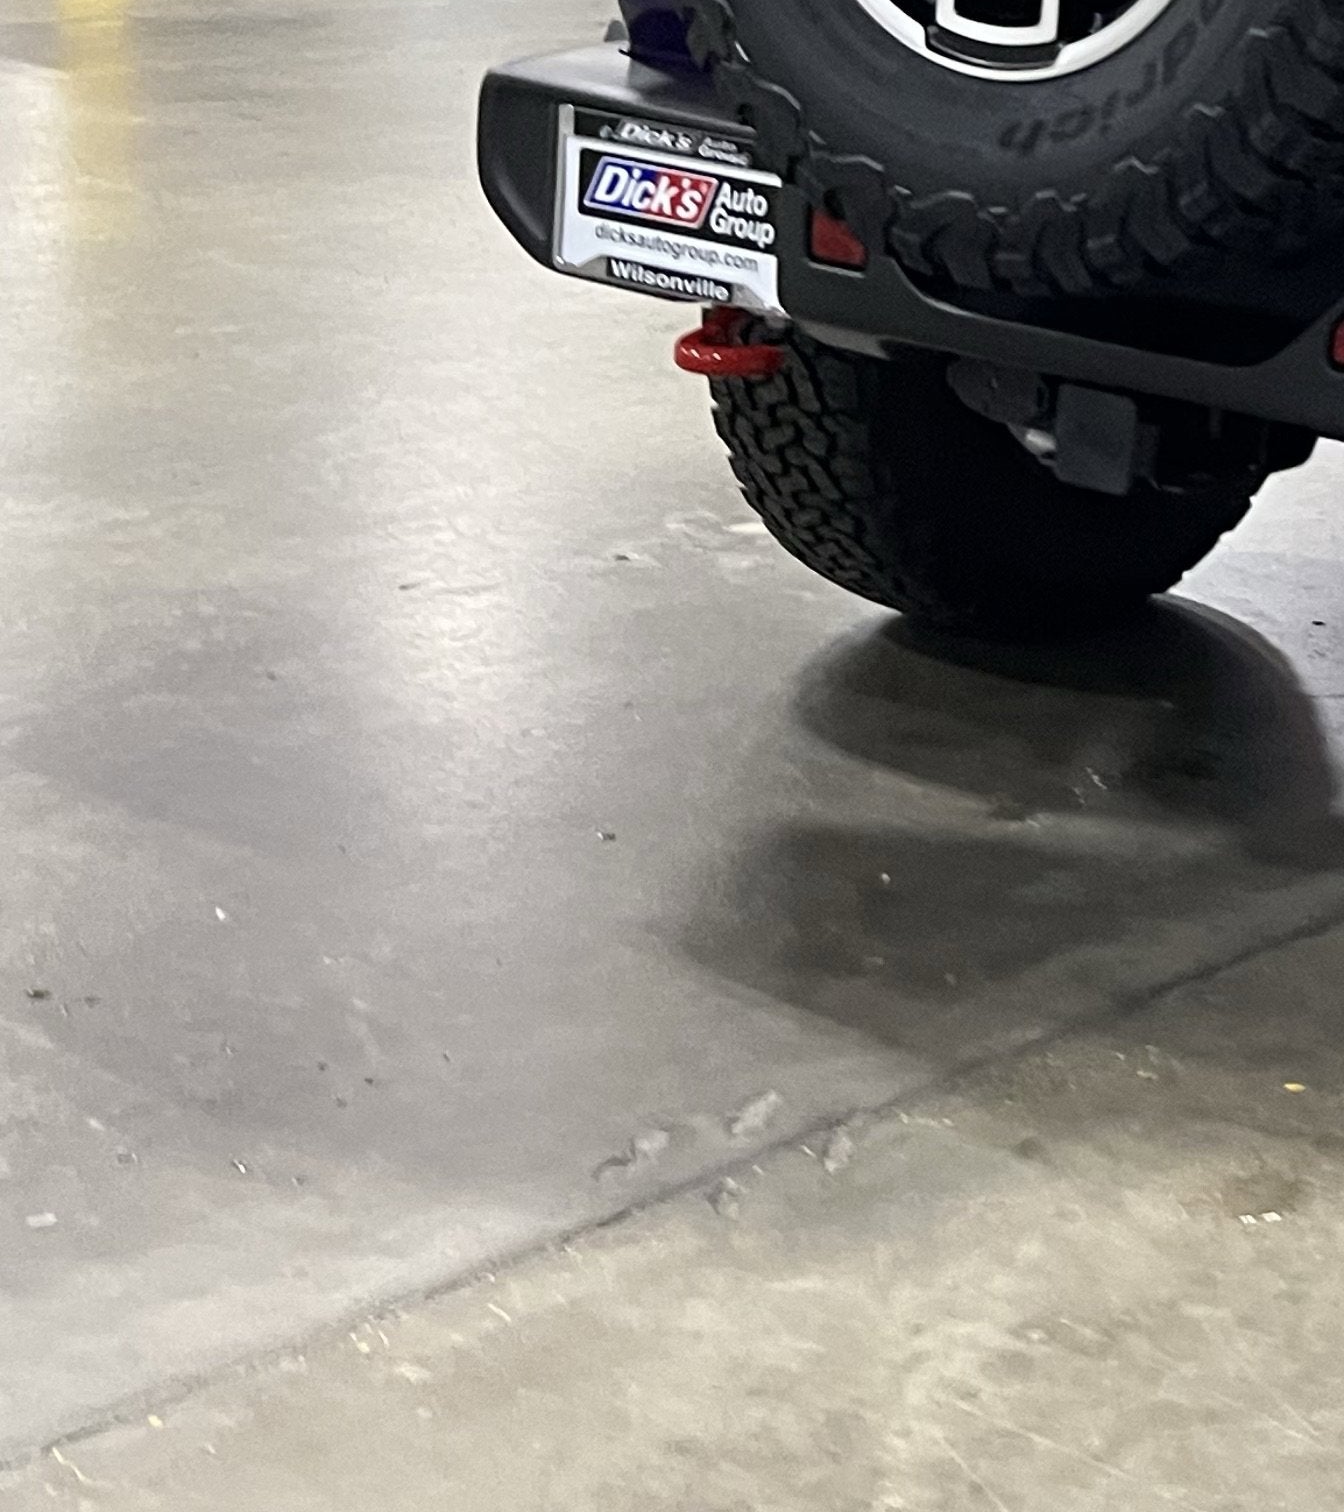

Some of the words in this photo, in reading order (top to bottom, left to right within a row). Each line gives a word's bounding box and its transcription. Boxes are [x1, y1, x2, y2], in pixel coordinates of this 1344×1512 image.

[594, 164, 703, 221] Dick's
[716, 181, 769, 218] Auto
[595, 223, 759, 273] dicksautogroup.com
[709, 210, 776, 249] Group
[610, 258, 729, 301] Wilsonville
